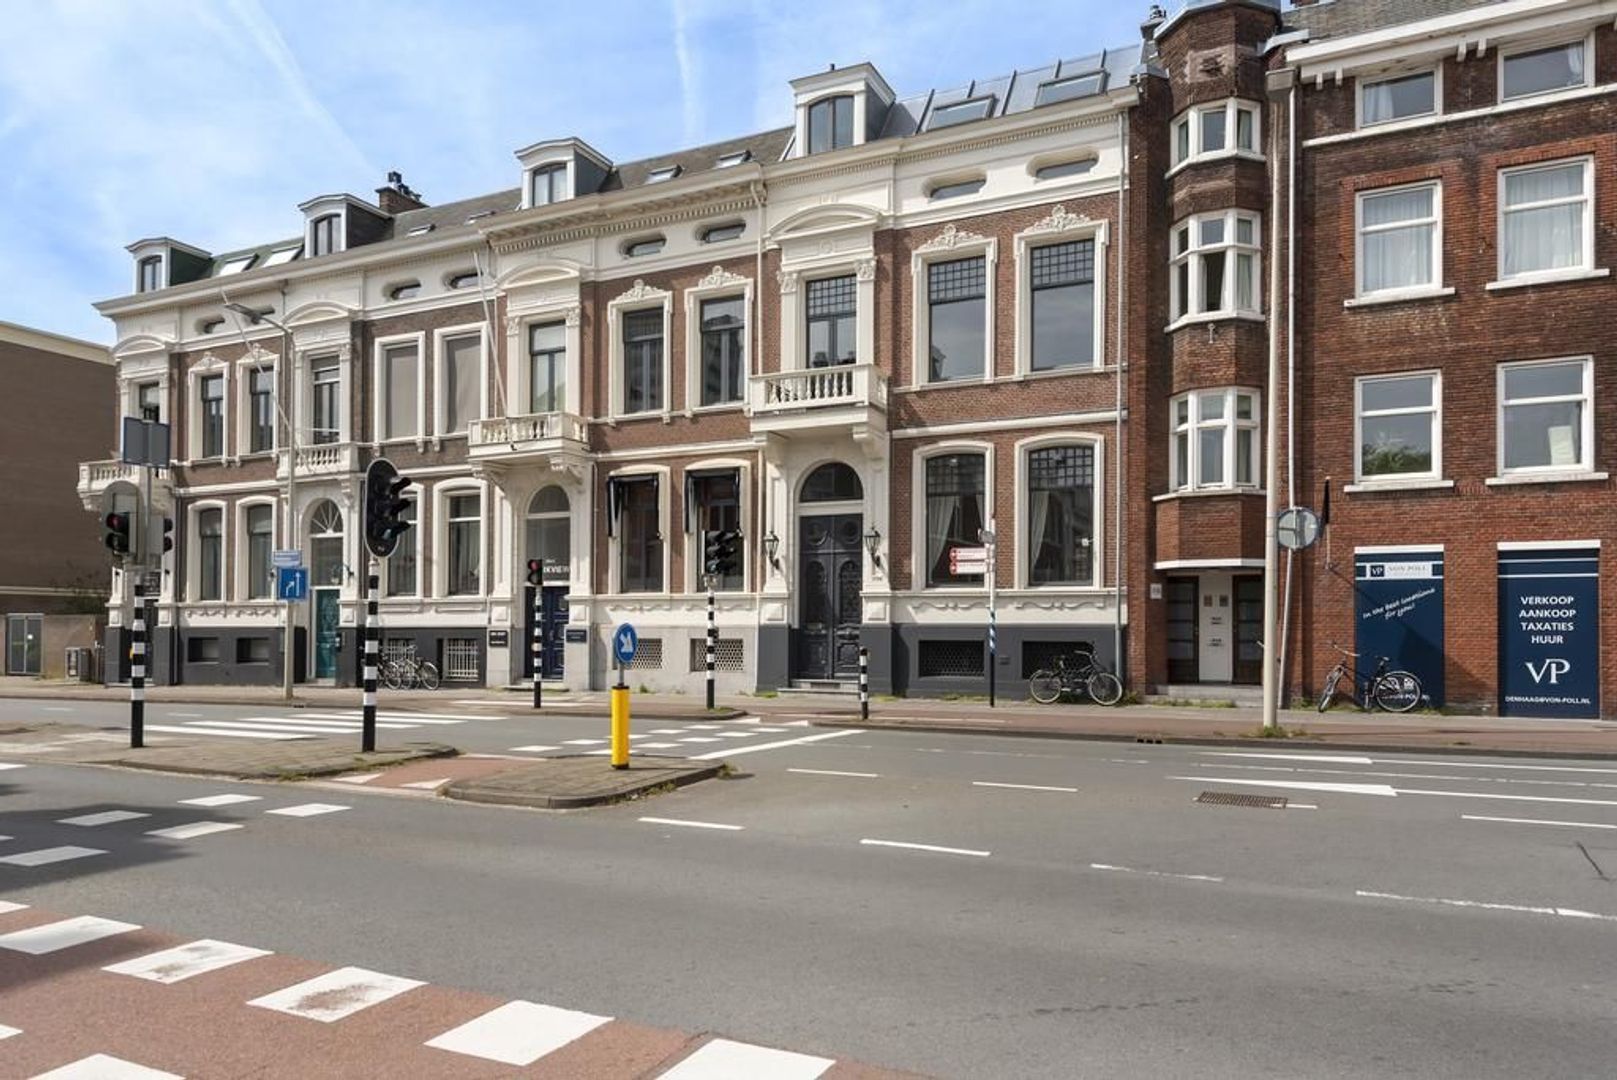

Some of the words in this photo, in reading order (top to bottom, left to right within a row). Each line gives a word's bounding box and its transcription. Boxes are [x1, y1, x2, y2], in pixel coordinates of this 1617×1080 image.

[1520, 596, 1574, 605] VERKOOP
[1519, 609, 1577, 618] AANKOOP
[1520, 622, 1574, 631] TAXATIES
[1531, 635, 1564, 644] HUUR
[1525, 659, 1571, 684] VP
[1505, 695, 1591, 704] DENHAAG@VON-POLL.NL
